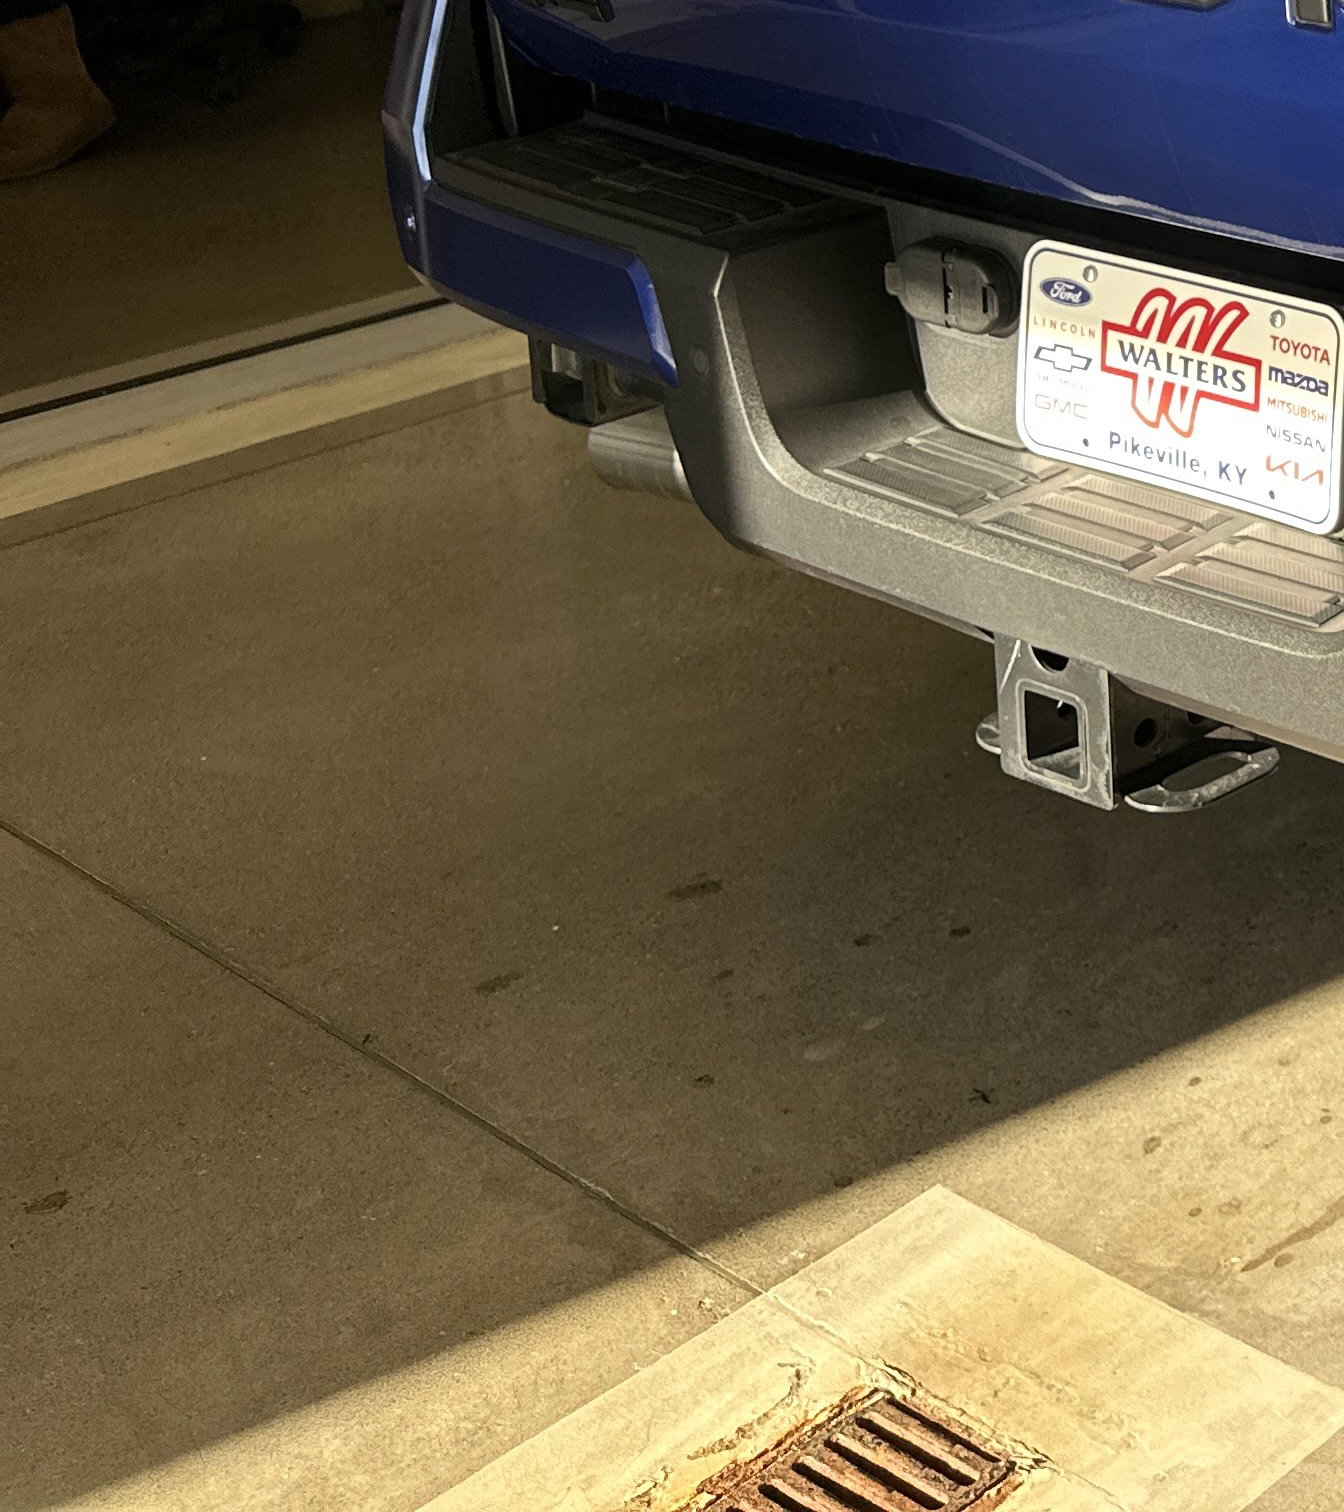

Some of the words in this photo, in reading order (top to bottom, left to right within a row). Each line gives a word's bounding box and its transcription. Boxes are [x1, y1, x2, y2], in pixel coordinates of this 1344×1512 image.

[1048, 279, 1085, 305] Ford
[1033, 315, 1096, 339] LINCOLN
[1269, 334, 1331, 366] TOYOTA
[1116, 338, 1247, 394] WALTERS
[1034, 393, 1088, 419] GMC
[1266, 396, 1328, 423] MITSUBISHI
[1266, 424, 1326, 453] NISSAN
[1109, 430, 1208, 481] Pikeville,
[1218, 460, 1248, 486] KY
[1265, 454, 1324, 486] KIA
